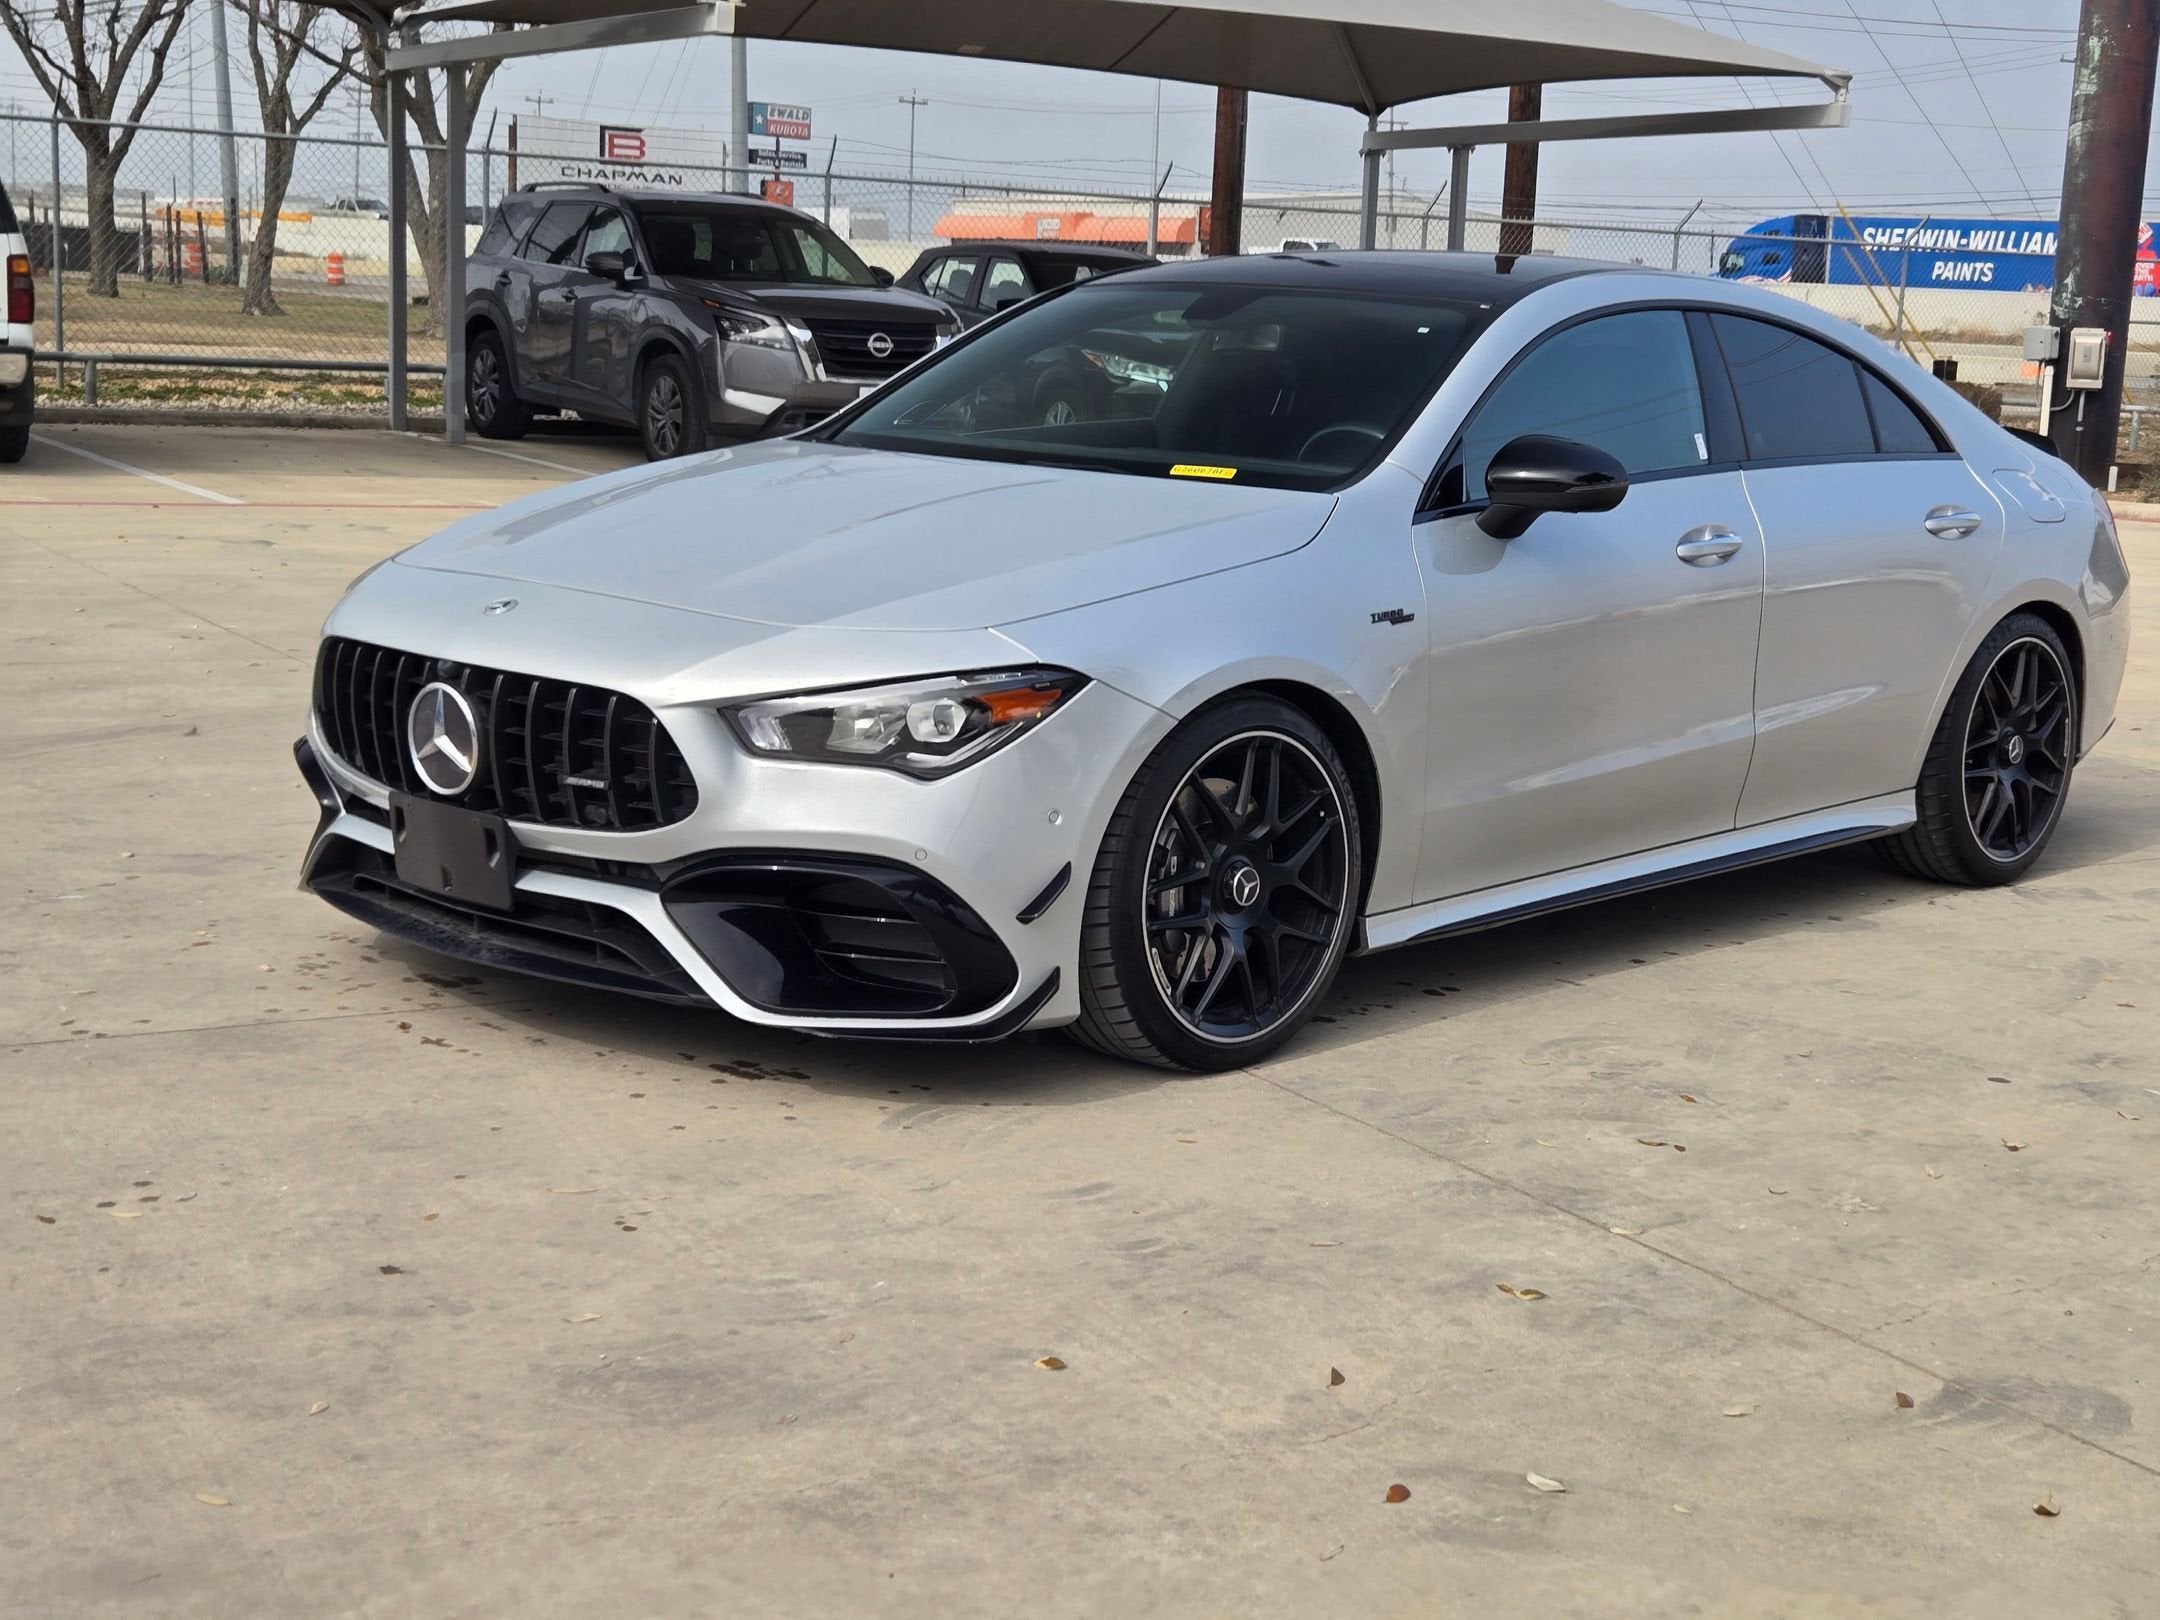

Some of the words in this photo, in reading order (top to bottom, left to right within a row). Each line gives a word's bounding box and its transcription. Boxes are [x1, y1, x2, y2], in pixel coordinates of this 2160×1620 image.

[769, 107, 809, 121] EWALD
[769, 123, 808, 137] KUBOTA
[561, 166, 683, 185] CHAPMAN
[1861, 227, 2059, 255] SHERWIN-WILLIAM
[1931, 261, 1994, 282] PAINTS
[1370, 608, 1404, 624] TURBO
